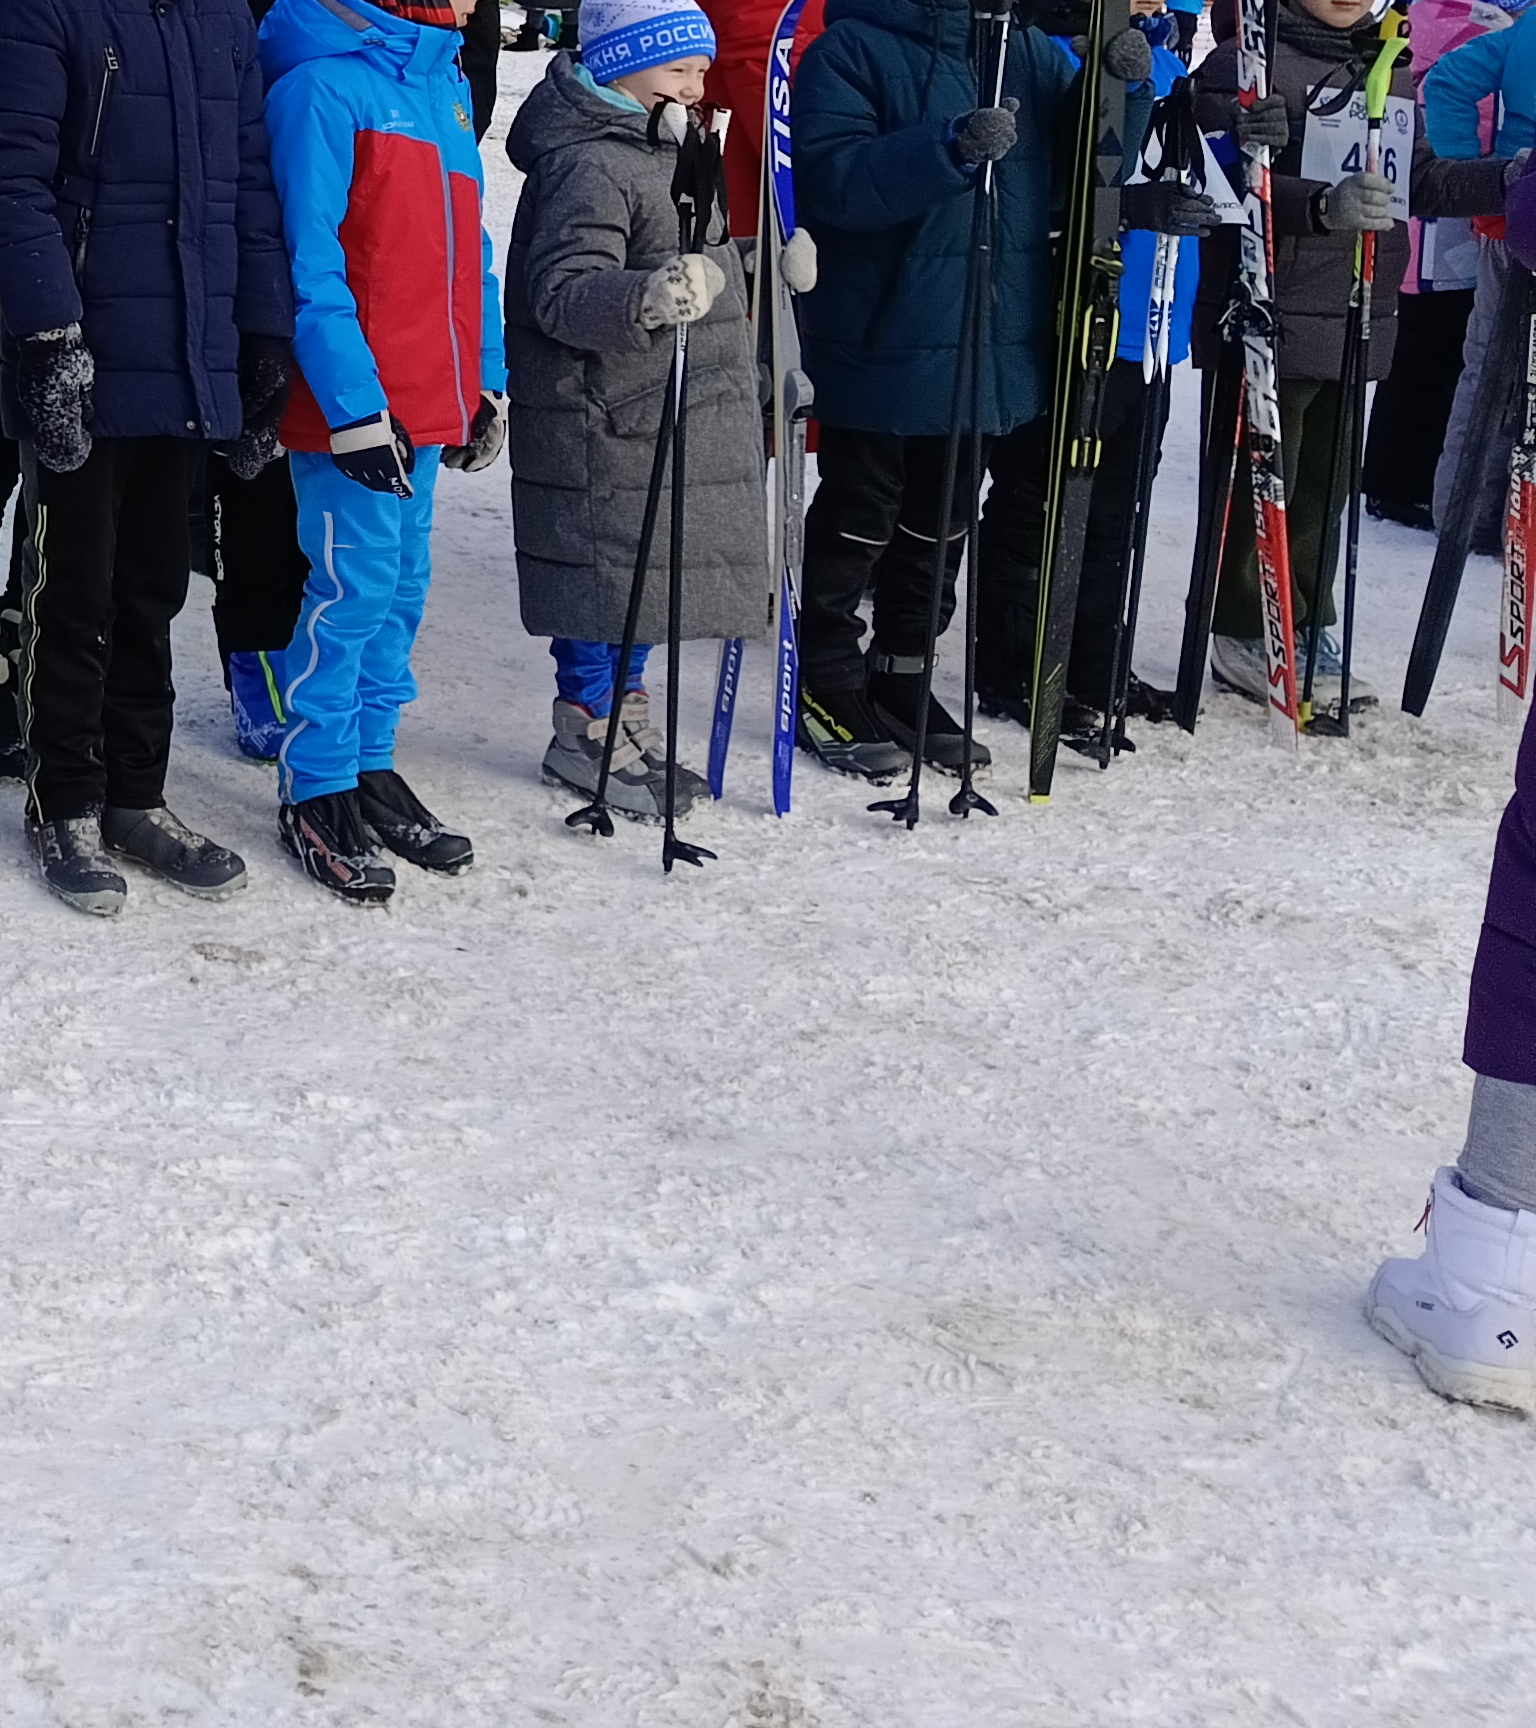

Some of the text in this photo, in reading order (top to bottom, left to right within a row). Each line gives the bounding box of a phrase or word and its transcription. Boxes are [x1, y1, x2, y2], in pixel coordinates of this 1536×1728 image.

[773, 35, 795, 173] TISA
[1341, 140, 1397, 186] 46
[780, 639, 793, 733] sport
[1269, 665, 1288, 714] LS
[1499, 634, 1526, 700] LS
